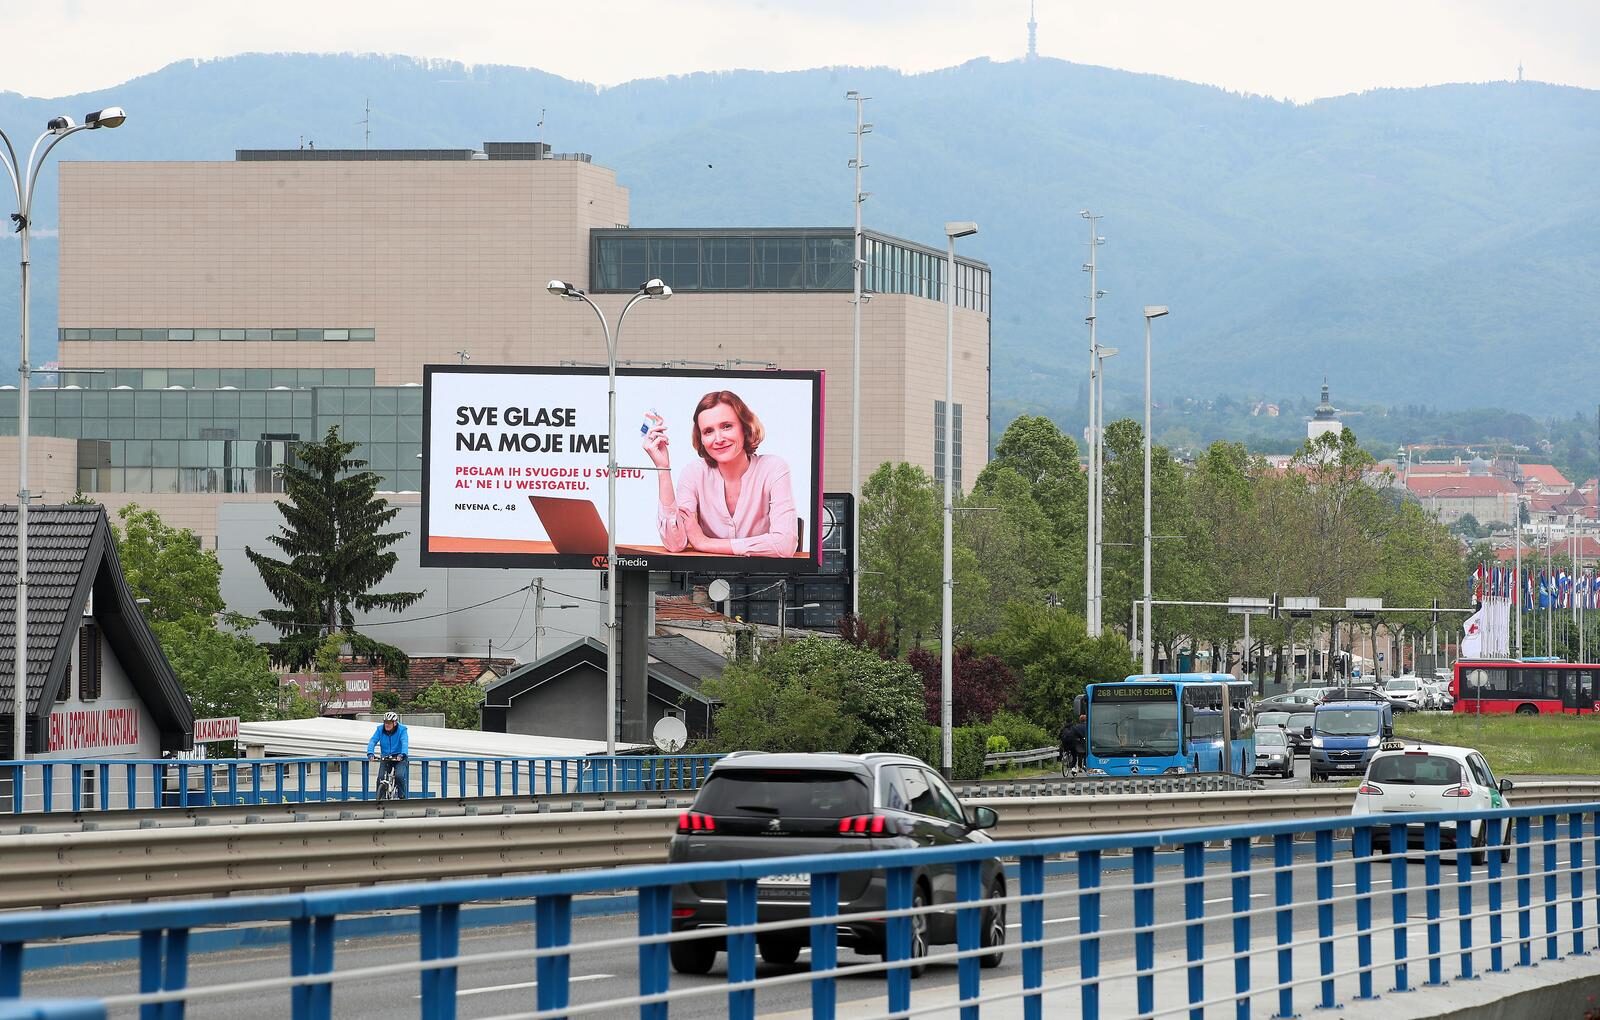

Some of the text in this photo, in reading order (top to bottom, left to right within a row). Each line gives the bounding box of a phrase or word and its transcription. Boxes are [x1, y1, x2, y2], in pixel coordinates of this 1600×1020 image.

[456, 406, 576, 427] SVE GLASE
[456, 432, 609, 453] NA MOJE IME
[455, 466, 645, 480] PEGLAM IH SVUGDJE U SVJETU,
[455, 479, 590, 491] AL' NE I U WESTGATEU.
[454, 503, 490, 511] NEVENA
[618, 558, 648, 567] media
[1097, 688, 1173, 697] 268 VELIKA GORICA
[69, 710, 100, 750] POPRAVAK
[100, 708, 139, 747] AUTOSTAKLA
